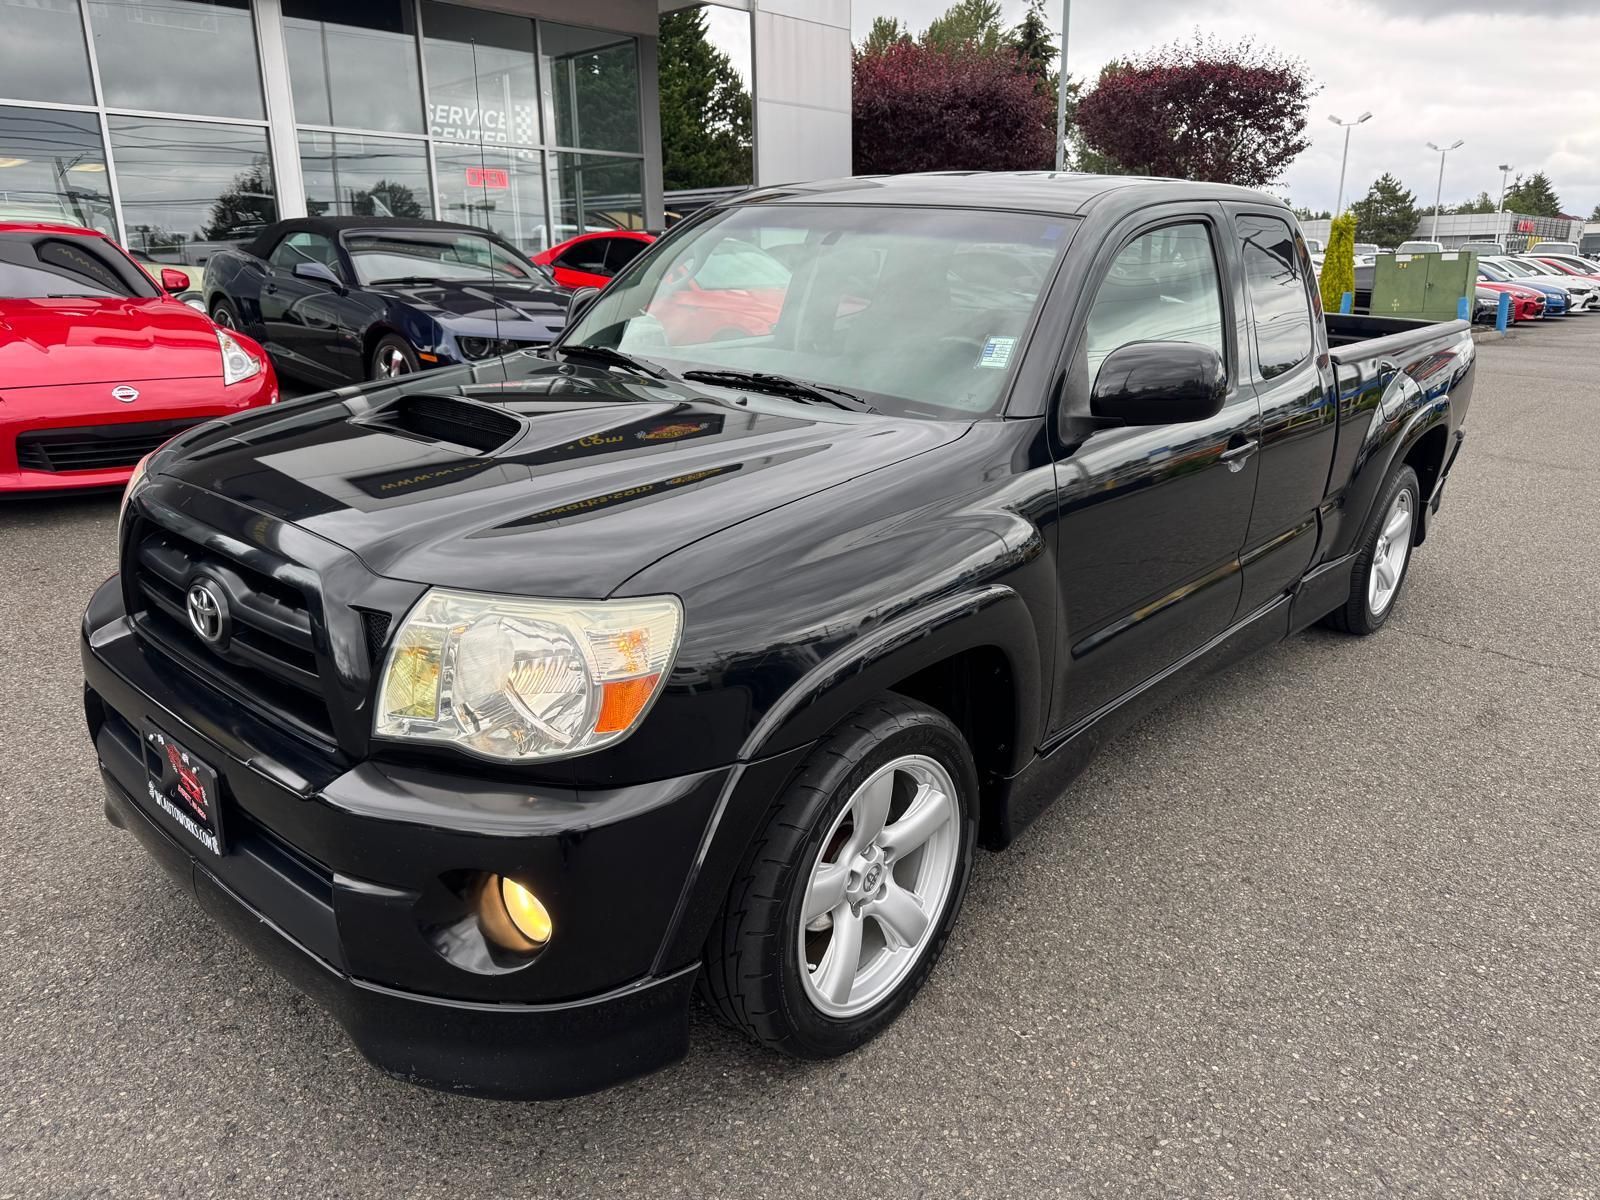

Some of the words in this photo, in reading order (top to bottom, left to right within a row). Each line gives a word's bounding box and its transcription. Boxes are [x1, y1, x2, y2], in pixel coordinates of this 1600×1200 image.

[430, 104, 506, 129] SERVICE
[431, 127, 507, 150] CENTER
[469, 171, 505, 187] OPEN
